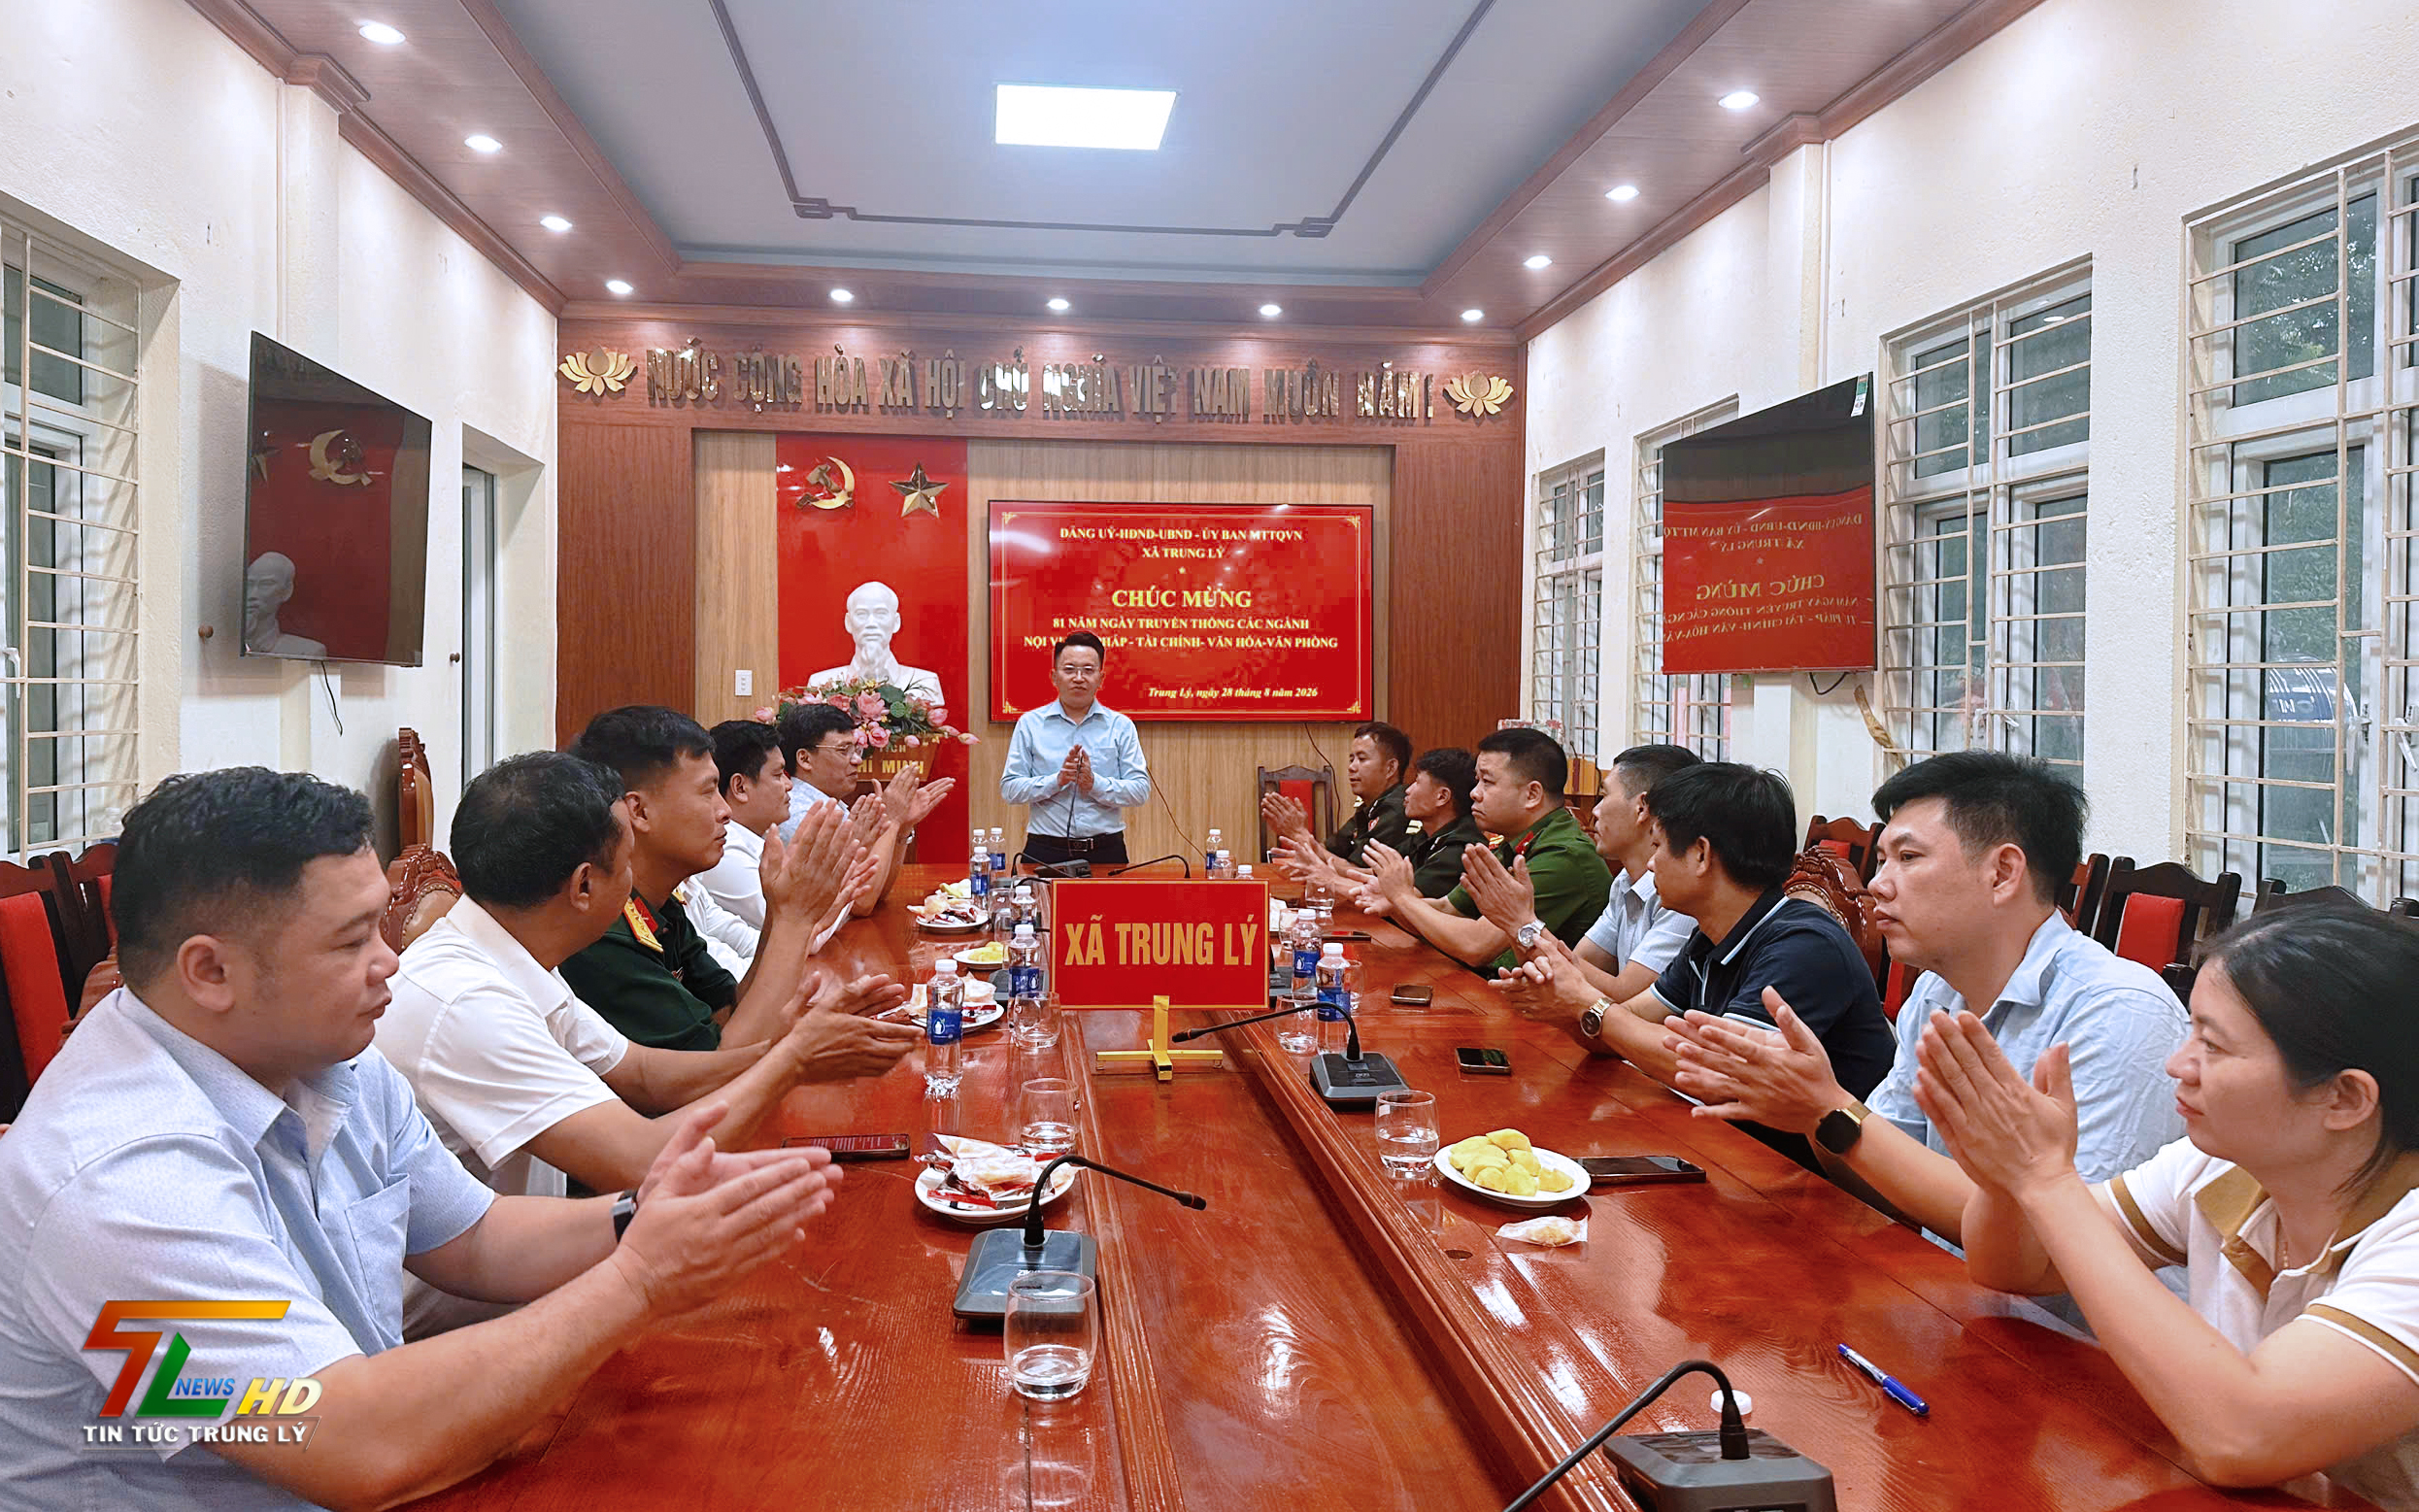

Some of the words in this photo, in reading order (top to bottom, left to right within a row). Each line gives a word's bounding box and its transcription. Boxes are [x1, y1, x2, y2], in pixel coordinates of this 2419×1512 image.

[816, 343, 869, 406] HÒA
[878, 348, 914, 408] XÃ
[925, 349, 967, 419] HỘI
[979, 346, 1029, 411] CHỦ
[1128, 354, 1178, 424] VIỆT
[1193, 367, 1251, 416] NAM
[1263, 358, 1339, 418] MUÔN
[1222, 530, 1246, 540] BAN
[1250, 530, 1303, 542] MTTQVN
[1163, 548, 1205, 558] TRUNG
[1208, 545, 1225, 558] LÝ
[1112, 585, 1176, 607] CHÚC
[1183, 585, 1252, 608] MỪNG
[1053, 618, 1064, 628] 81
[1068, 616, 1096, 628] NĂM
[1100, 616, 1135, 628] NGÀY
[1237, 616, 1262, 629] CÁC
[1265, 616, 1309, 629] NGÀNH
[1099, 634, 1127, 647] HÁP
[1136, 634, 1157, 647] TÀI
[1207, 635, 1232, 648] VĂN
[1294, 635, 1338, 648] PHÒNG
[1149, 688, 1176, 698] Trung
[1196, 688, 1219, 698] ngày
[1222, 688, 1232, 697] 28
[1235, 688, 1261, 698] tháng
[1264, 688, 1270, 697] 8
[1294, 688, 1318, 697] 2026
[1064, 914, 1105, 966] XÃ
[1114, 922, 1213, 966] TRUNG
[1224, 914, 1259, 966] LÝ
